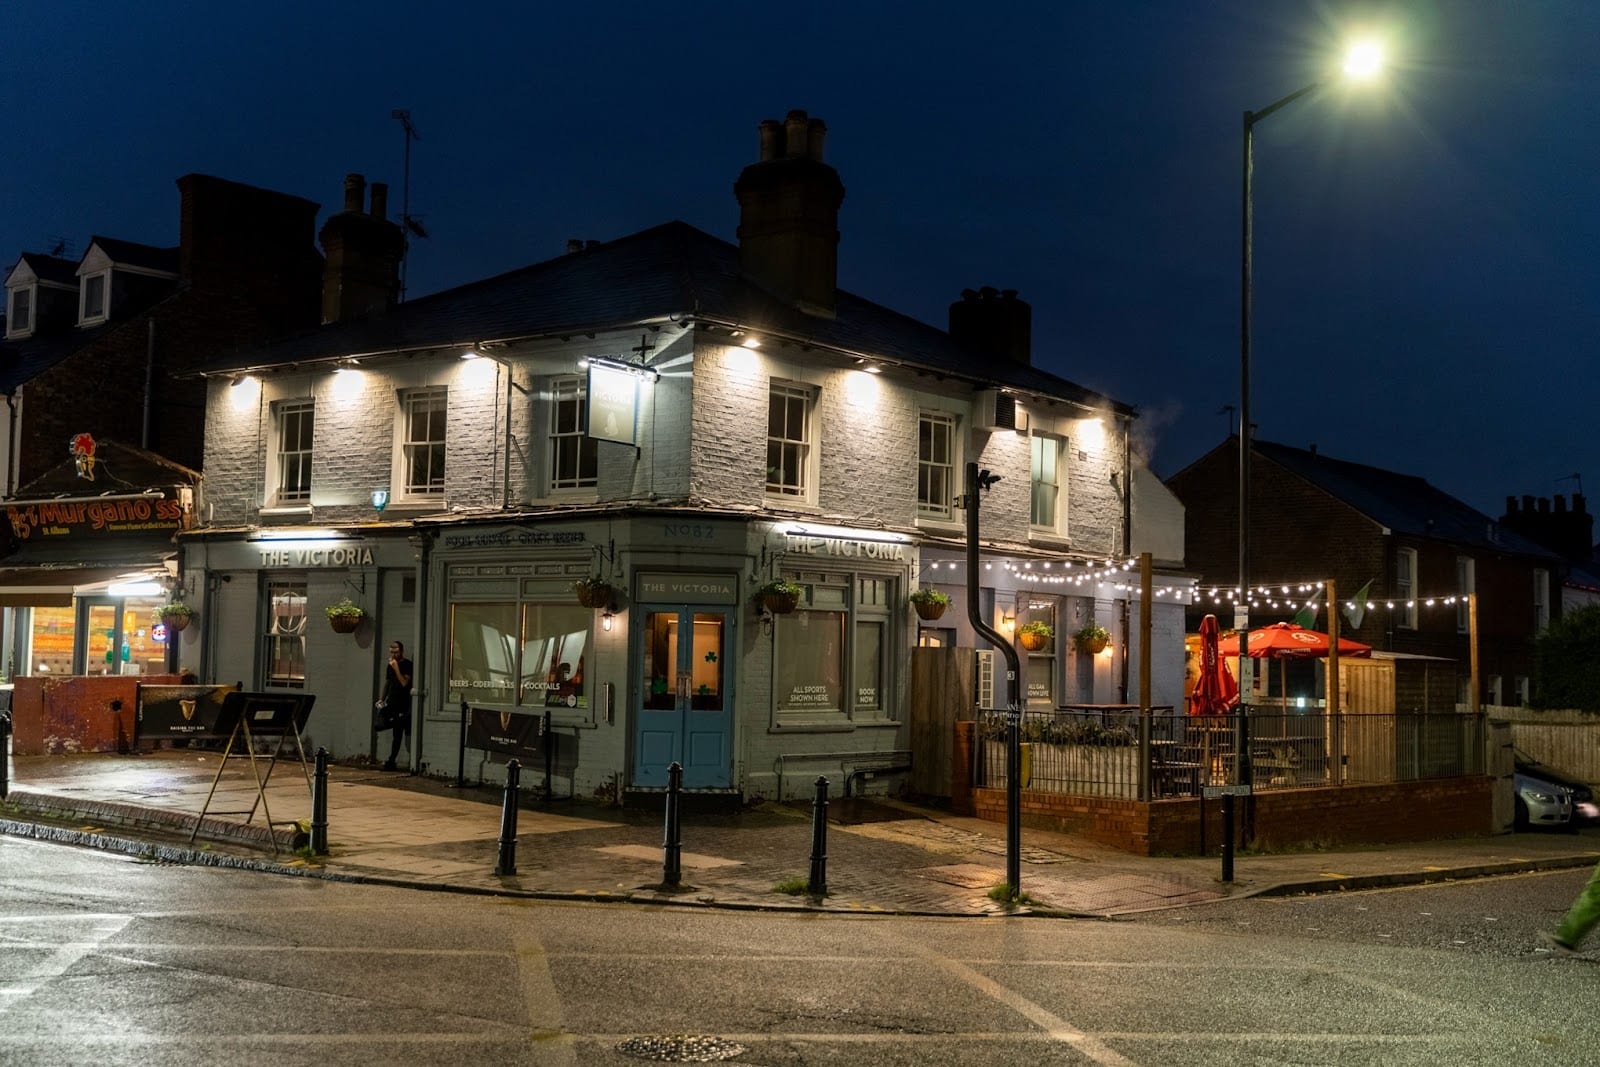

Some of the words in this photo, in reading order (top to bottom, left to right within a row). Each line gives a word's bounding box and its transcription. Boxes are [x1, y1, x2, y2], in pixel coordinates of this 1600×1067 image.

[786, 535, 817, 554] THE
[824, 538, 905, 560] VICTORIA
[260, 550, 289, 566] THE
[296, 547, 374, 565] VICTORIA
[643, 583, 665, 592] THE
[672, 584, 730, 593] VICTORIA
[449, 680, 469, 688] BEERS
[525, 681, 560, 690] COCKTAILS
[804, 685, 826, 693] SPORTS
[790, 694, 814, 702] SHOWN
